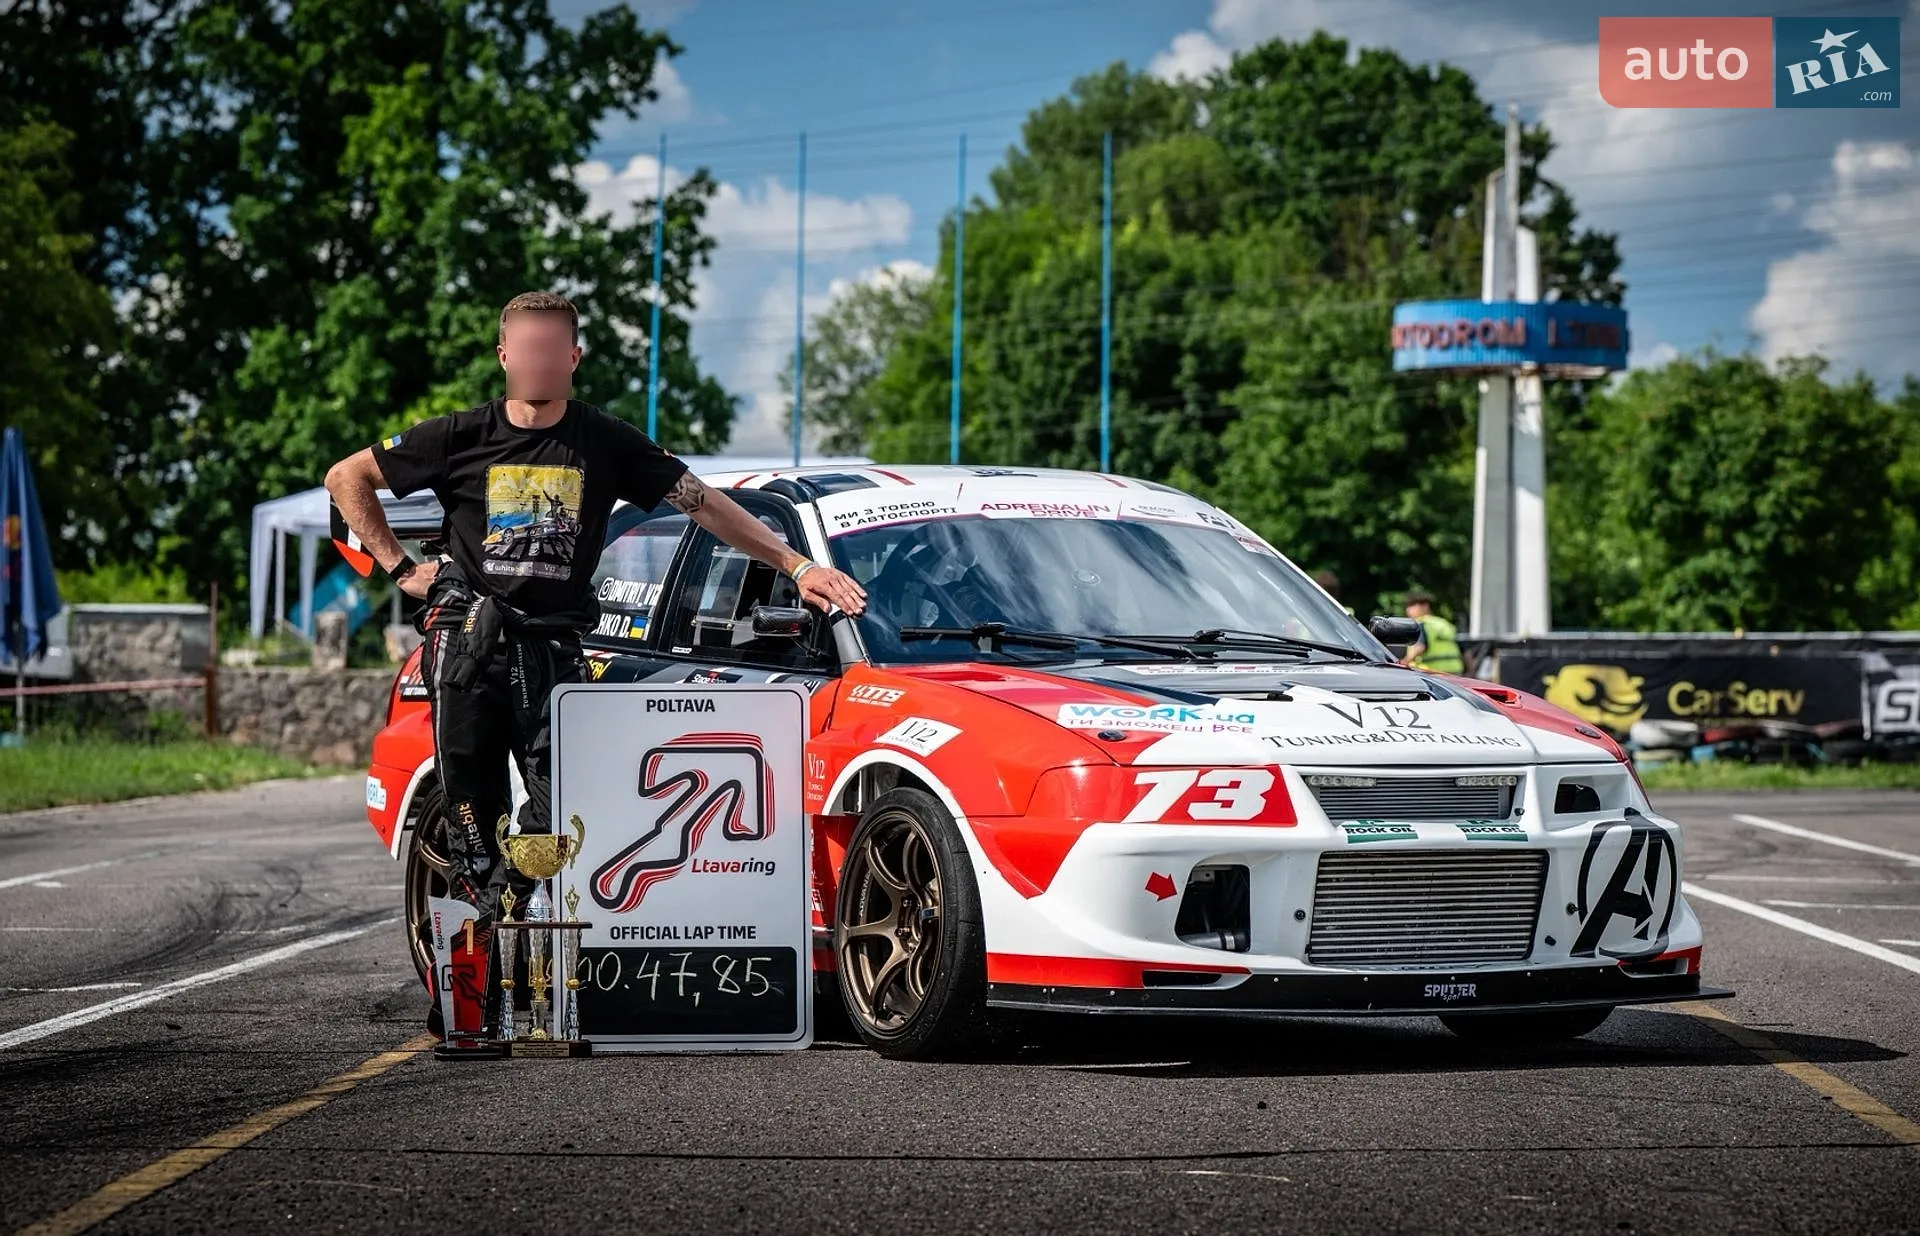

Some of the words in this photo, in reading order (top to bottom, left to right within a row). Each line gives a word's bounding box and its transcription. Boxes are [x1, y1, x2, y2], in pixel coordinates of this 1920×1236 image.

[878, 501, 935, 512] ТОБОЮ
[981, 503, 1111, 513] ADRENALIN
[646, 699, 715, 712] POLTAVA
[1667, 680, 1805, 716] CarServ
[1321, 702, 1432, 729] V12
[901, 721, 937, 743] V12
[1102, 720, 1203, 732] ЗМОЖЕШ
[1212, 724, 1254, 734] ВСЕ
[808, 753, 825, 779] V12
[1121, 769, 1274, 823] 73
[1345, 827, 1388, 835] ROCK
[691, 857, 776, 876] Ltavaring
[609, 925, 680, 940] OFFICIAL
[684, 925, 714, 940] LAP
[718, 925, 757, 940] TIME
